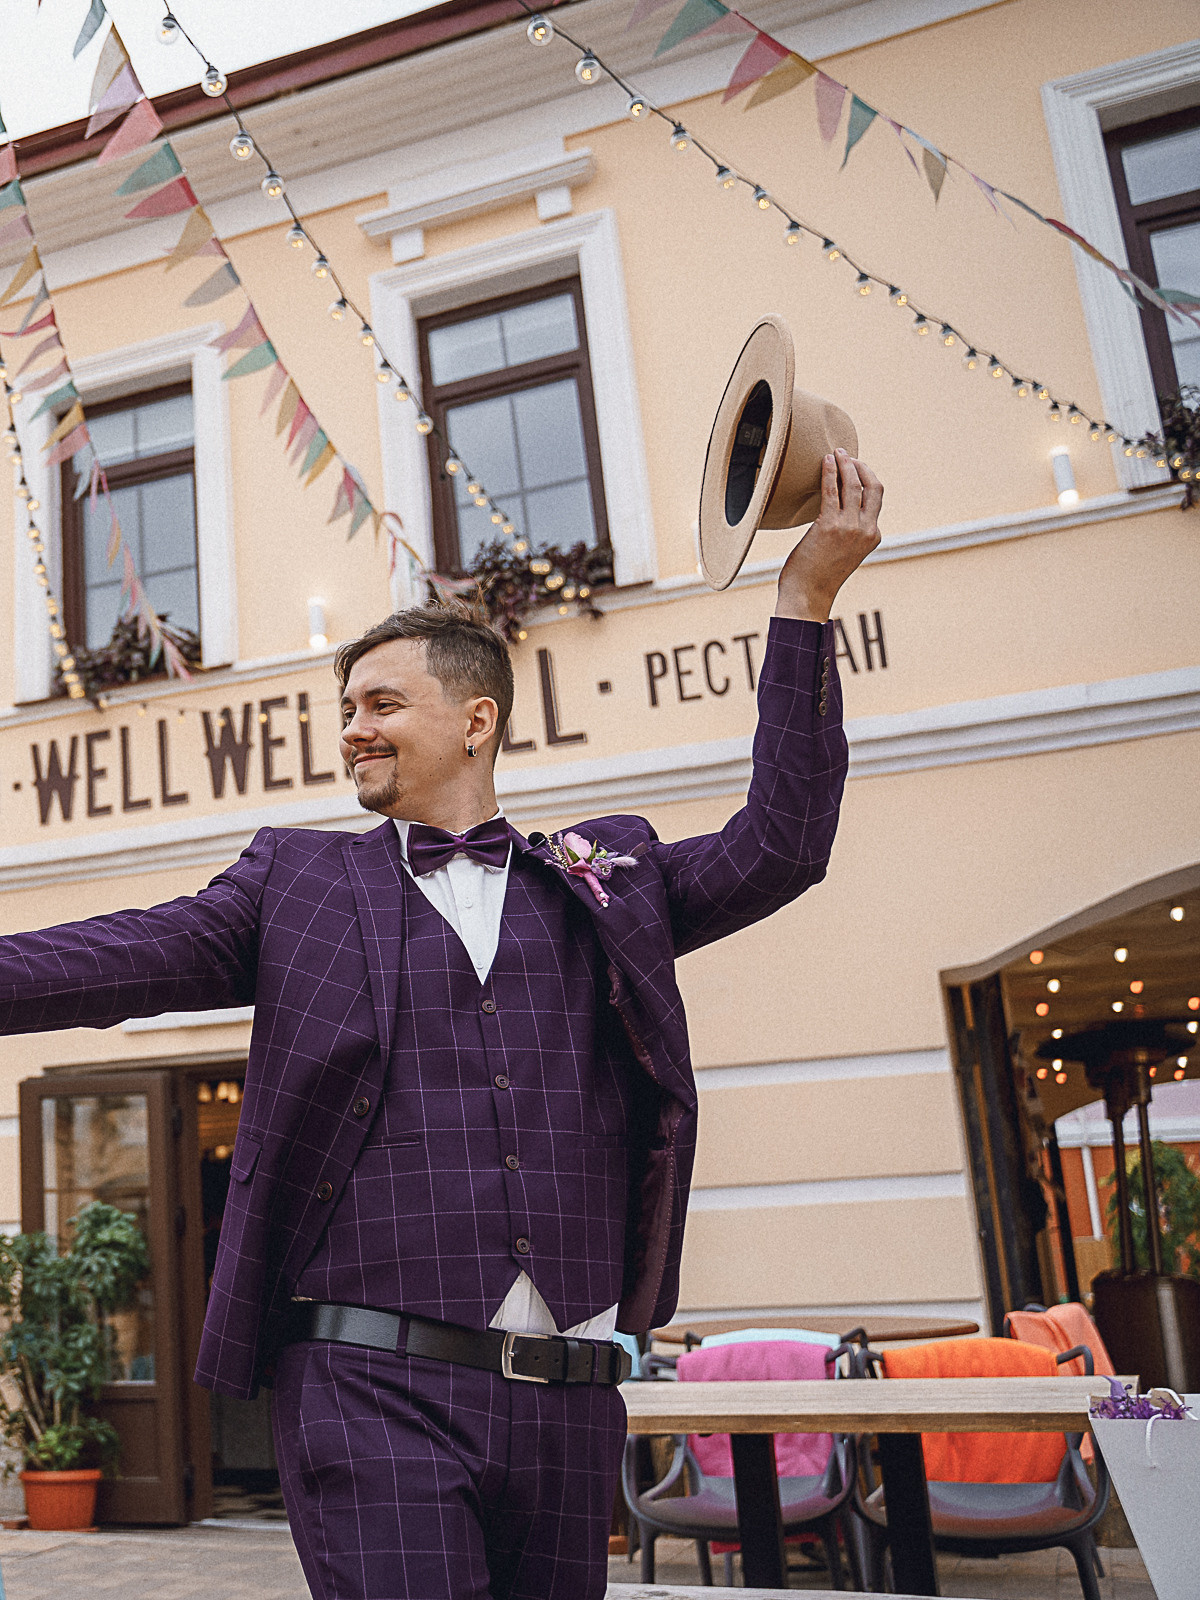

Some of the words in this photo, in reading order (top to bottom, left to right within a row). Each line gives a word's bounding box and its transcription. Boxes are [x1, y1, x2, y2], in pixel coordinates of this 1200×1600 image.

[645, 611, 888, 707] РЕСТАН
[31, 719, 189, 825] WELL
[202, 685, 348, 799] WEL
